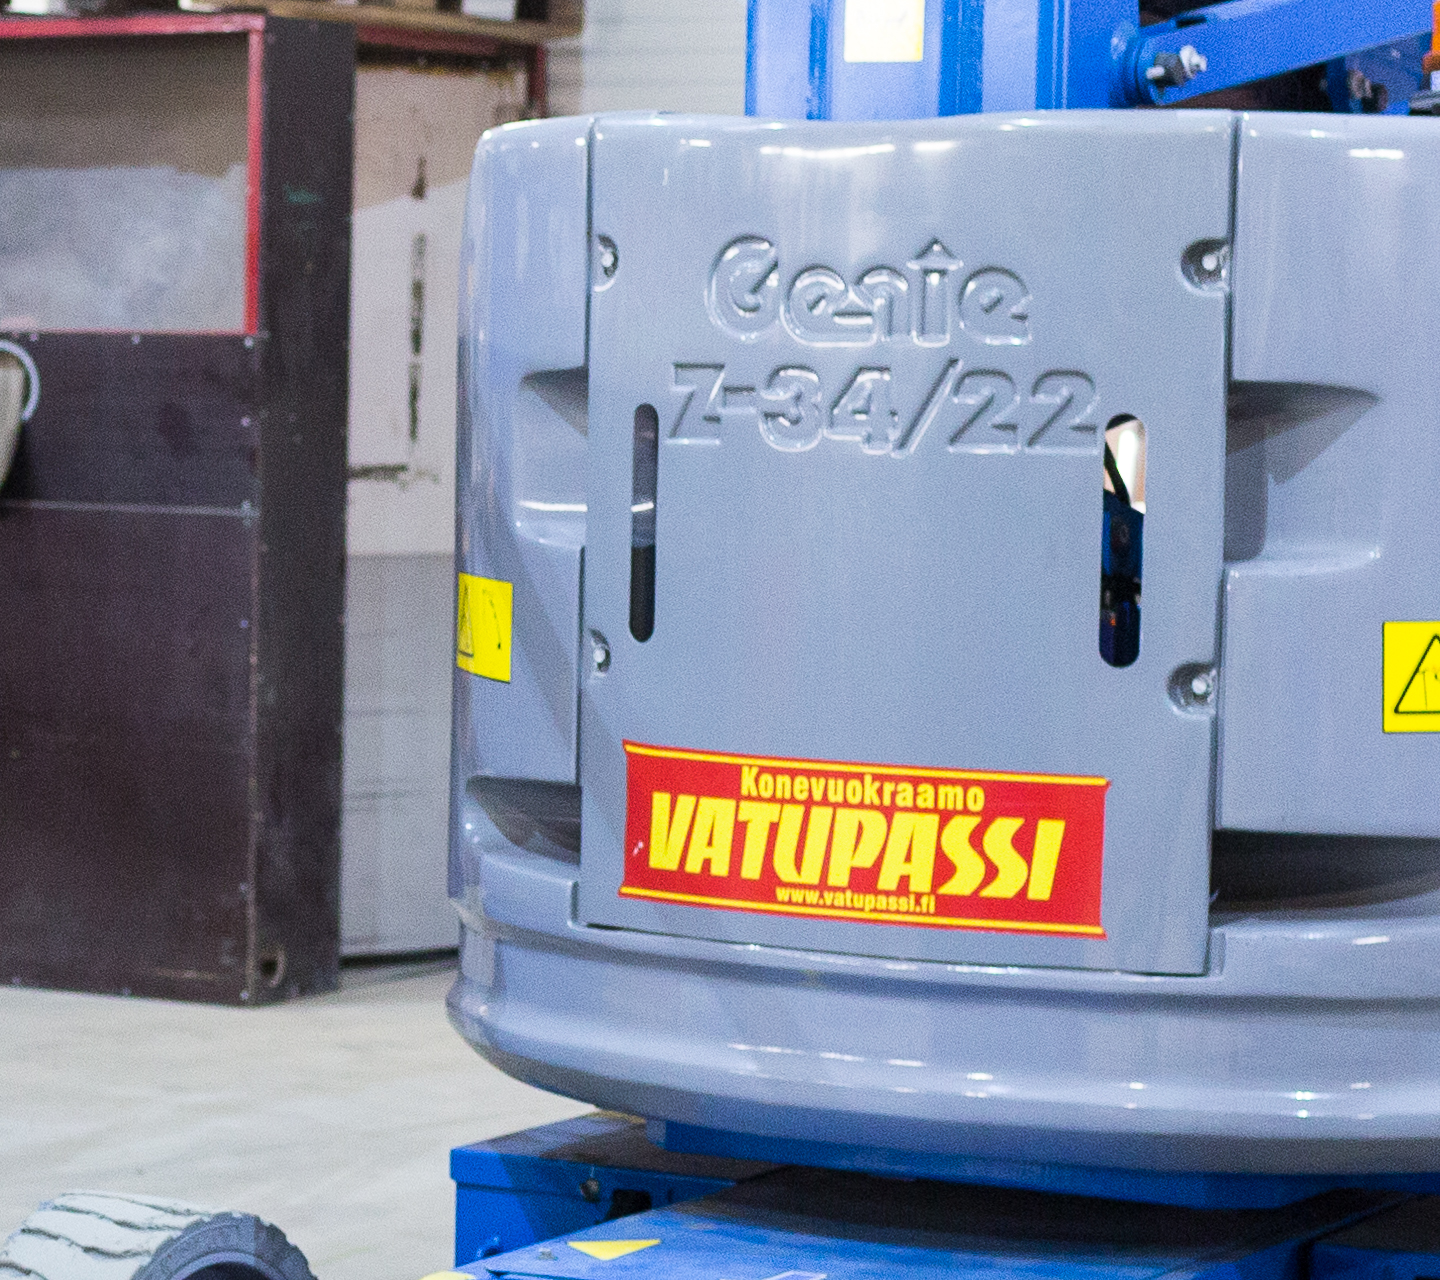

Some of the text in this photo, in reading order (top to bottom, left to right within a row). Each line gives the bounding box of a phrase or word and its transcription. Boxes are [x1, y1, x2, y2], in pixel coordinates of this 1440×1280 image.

[705, 233, 1034, 349] Genie
[666, 357, 1101, 459] Z-34/22
[740, 764, 986, 813] Konevuokraamo
[648, 791, 1067, 902] VATUPASSI
[775, 886, 937, 915] www.vatupassi.fi
